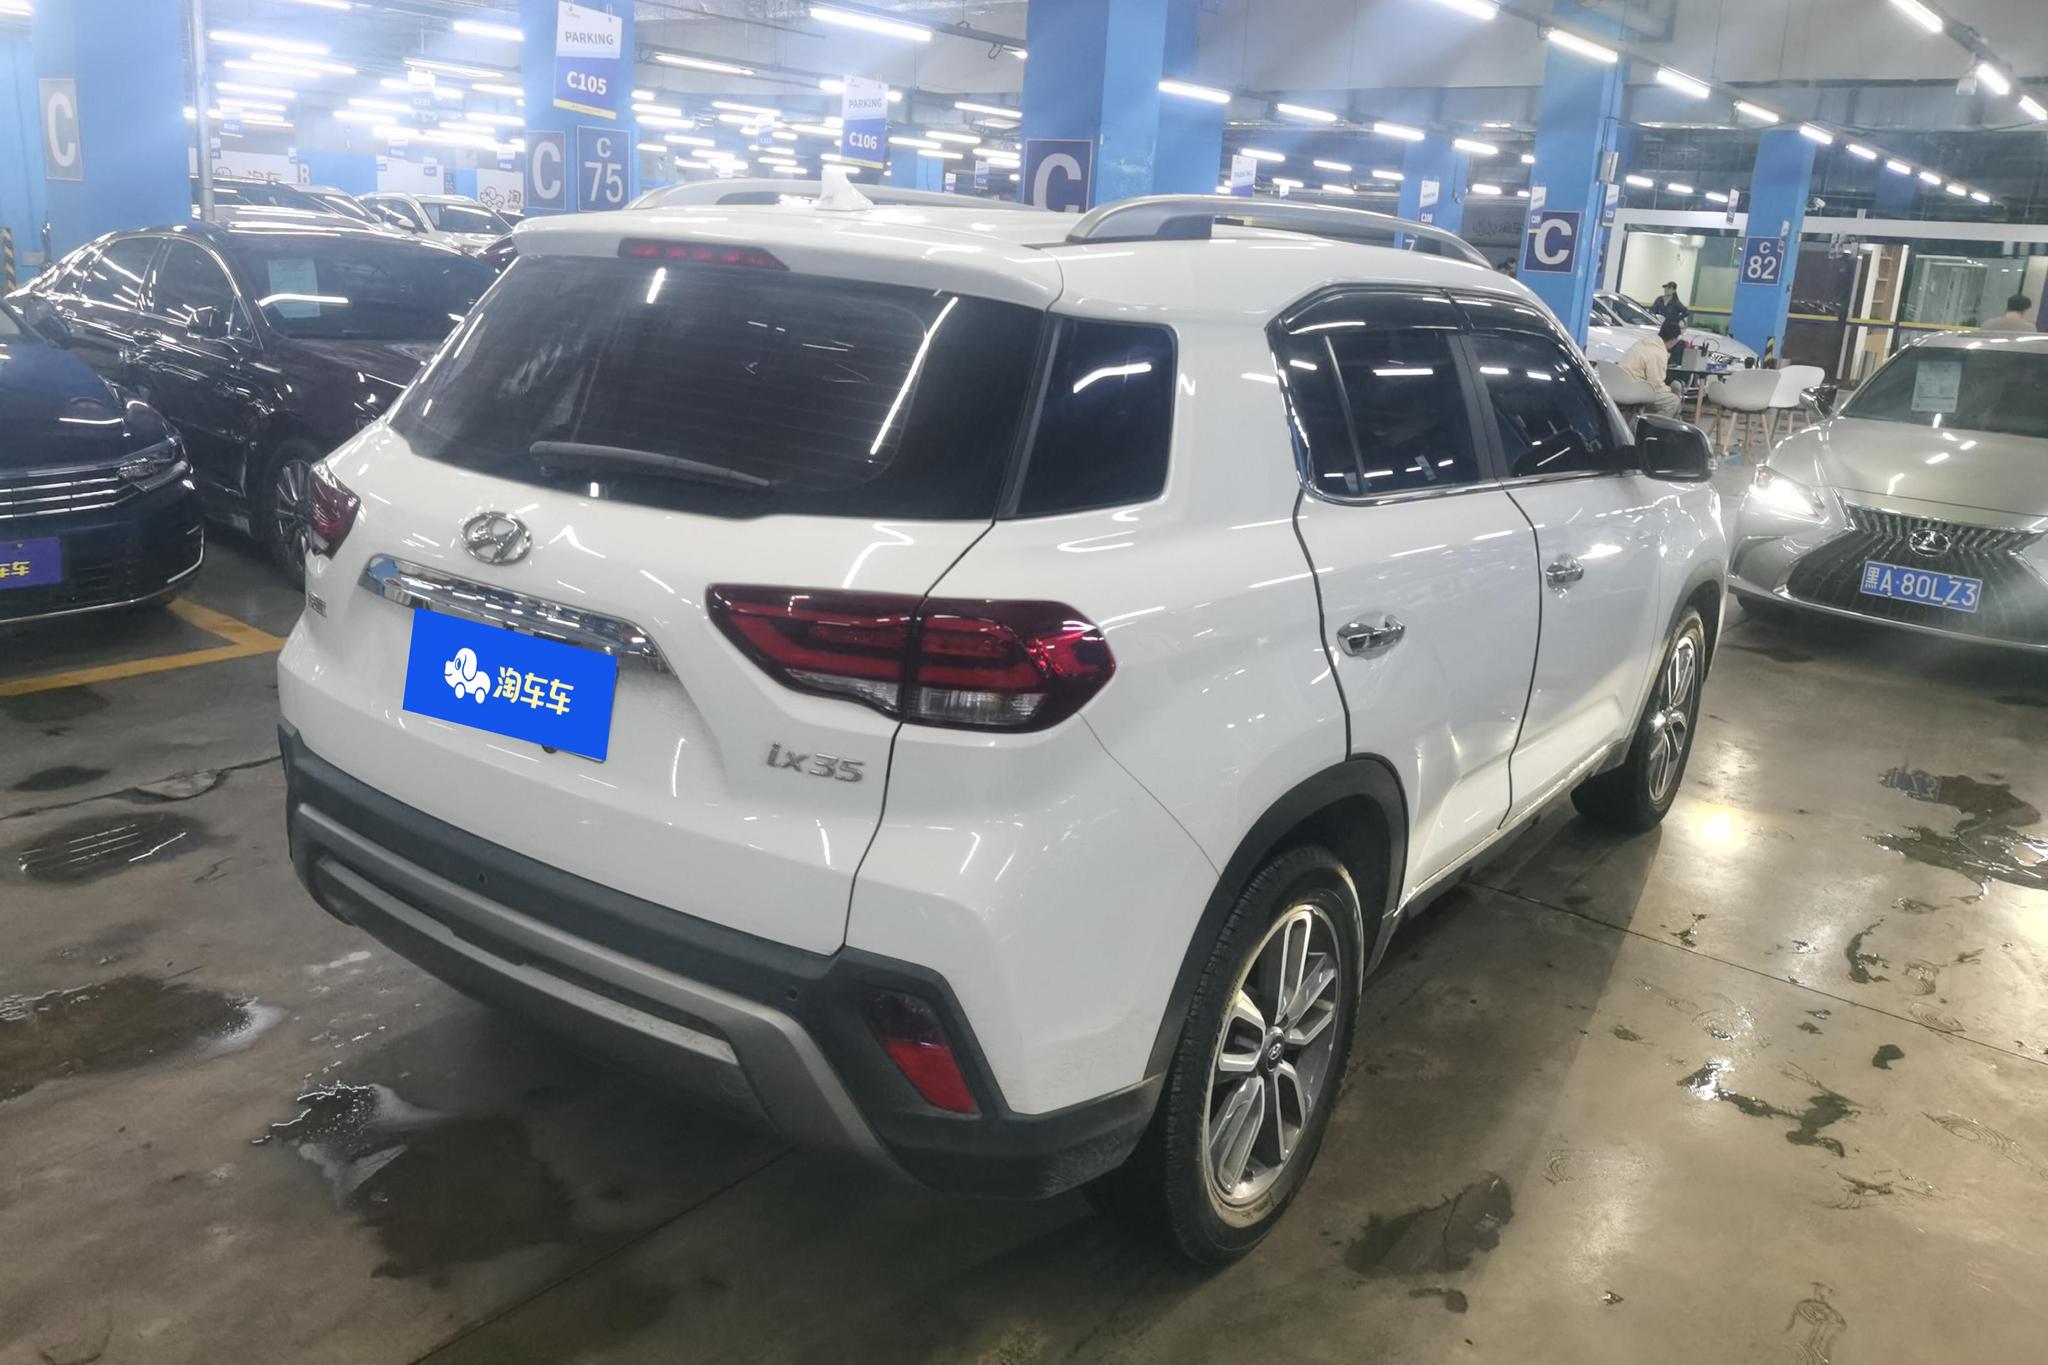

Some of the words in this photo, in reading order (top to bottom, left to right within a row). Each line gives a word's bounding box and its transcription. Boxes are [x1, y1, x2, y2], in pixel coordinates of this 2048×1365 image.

[565, 31, 614, 46] PARKING
[567, 71, 607, 95] C105
[849, 98, 883, 109] PARKING
[47, 92, 76, 167] C
[849, 132, 878, 150] C106
[597, 137, 611, 158] C
[532, 141, 561, 200] C
[585, 161, 623, 203] 75
[1033, 153, 1082, 213] C
[1534, 219, 1572, 265] C
[1759, 242, 1771, 254] C
[1747, 256, 1777, 280] 82
[767, 742, 865, 783] ix35
